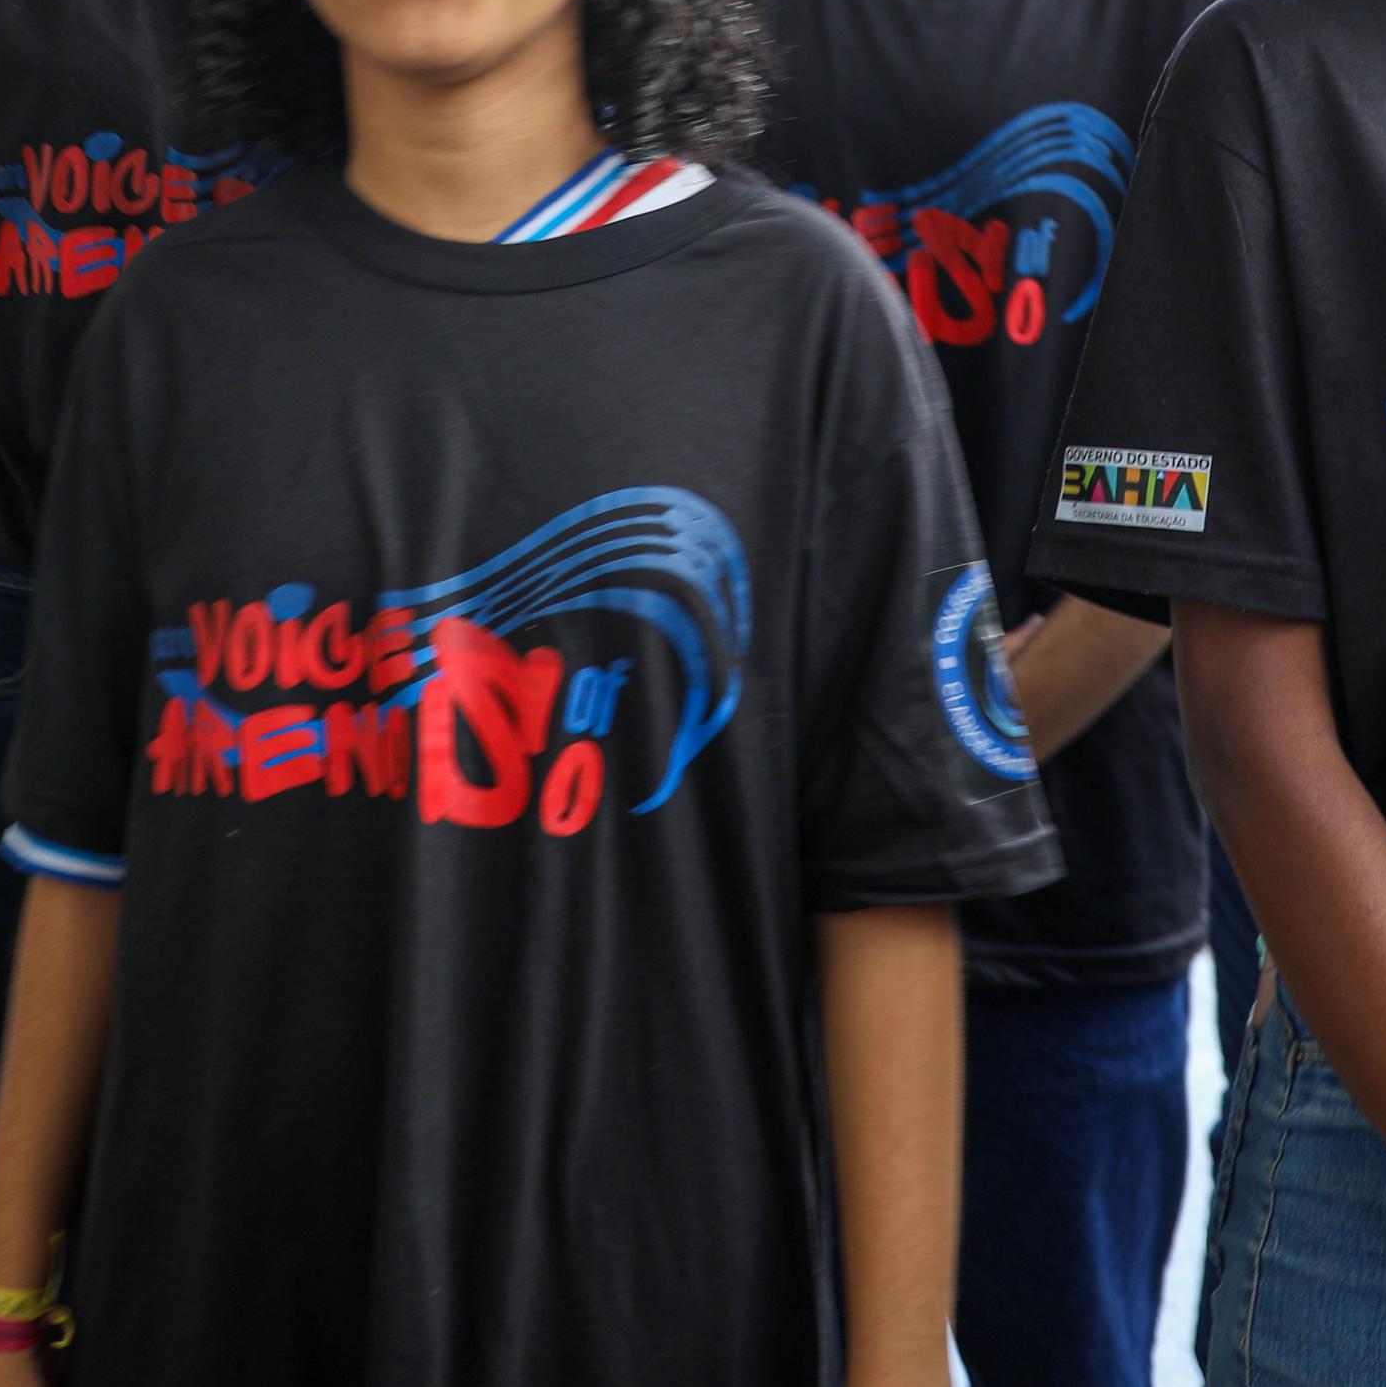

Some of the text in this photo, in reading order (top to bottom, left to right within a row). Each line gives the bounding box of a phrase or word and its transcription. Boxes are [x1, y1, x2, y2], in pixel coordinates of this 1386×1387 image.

[1065, 448, 1210, 471] GOVERNO DO ESTADO
